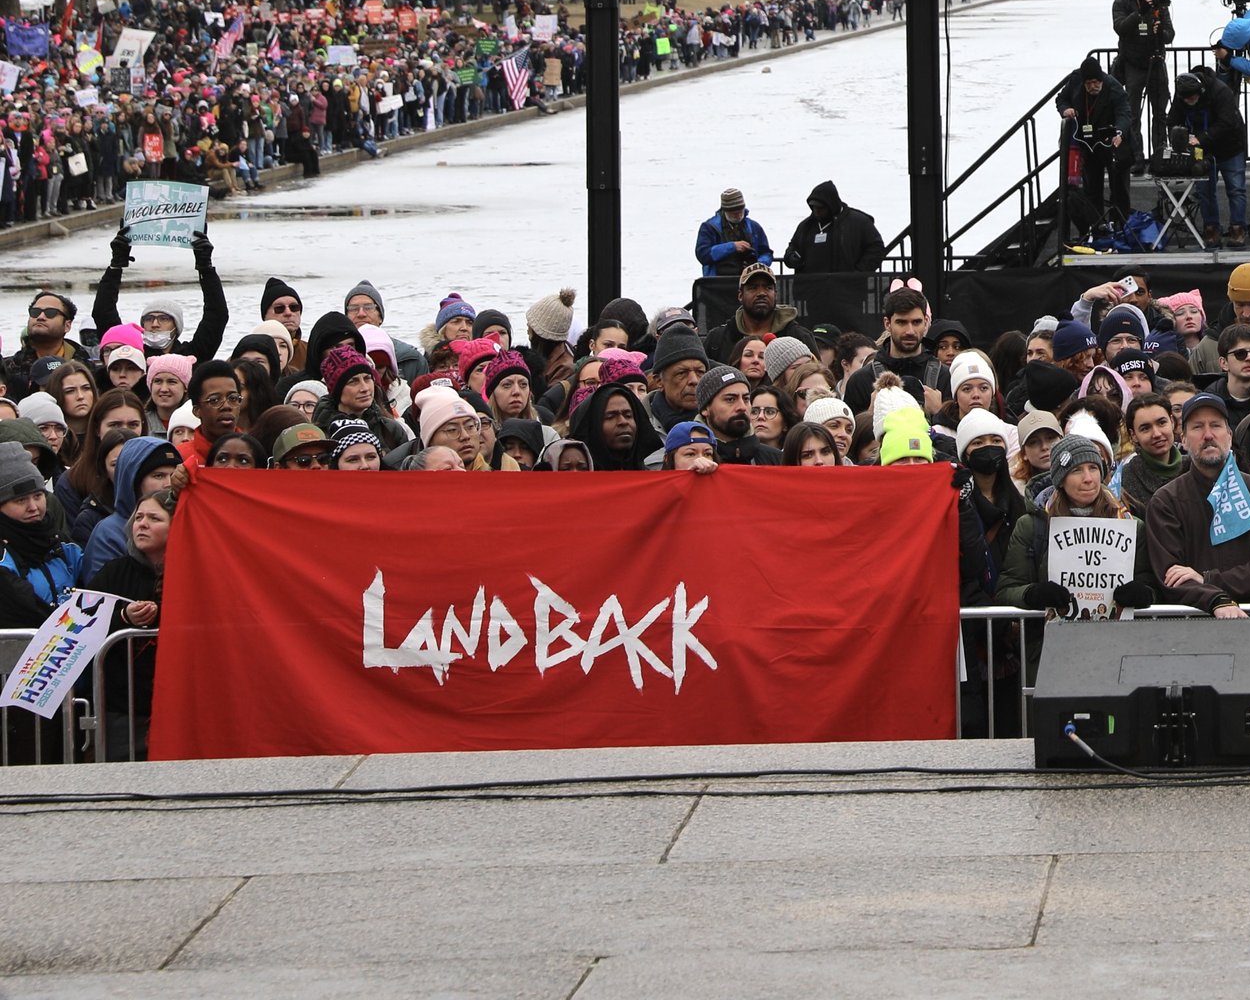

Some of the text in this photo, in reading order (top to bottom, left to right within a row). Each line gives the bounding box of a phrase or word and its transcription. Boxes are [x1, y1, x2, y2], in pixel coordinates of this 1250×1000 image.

[125, 202, 206, 221] UNGOVERNABLE
[162, 234, 192, 244] MARCH
[1120, 360, 1145, 373] RESIST
[1221, 481, 1232, 514] FOR
[1227, 464, 1250, 520] UNITED
[1054, 527, 1132, 552] FEMINISTS
[1060, 572, 1125, 589] FASCISTS
